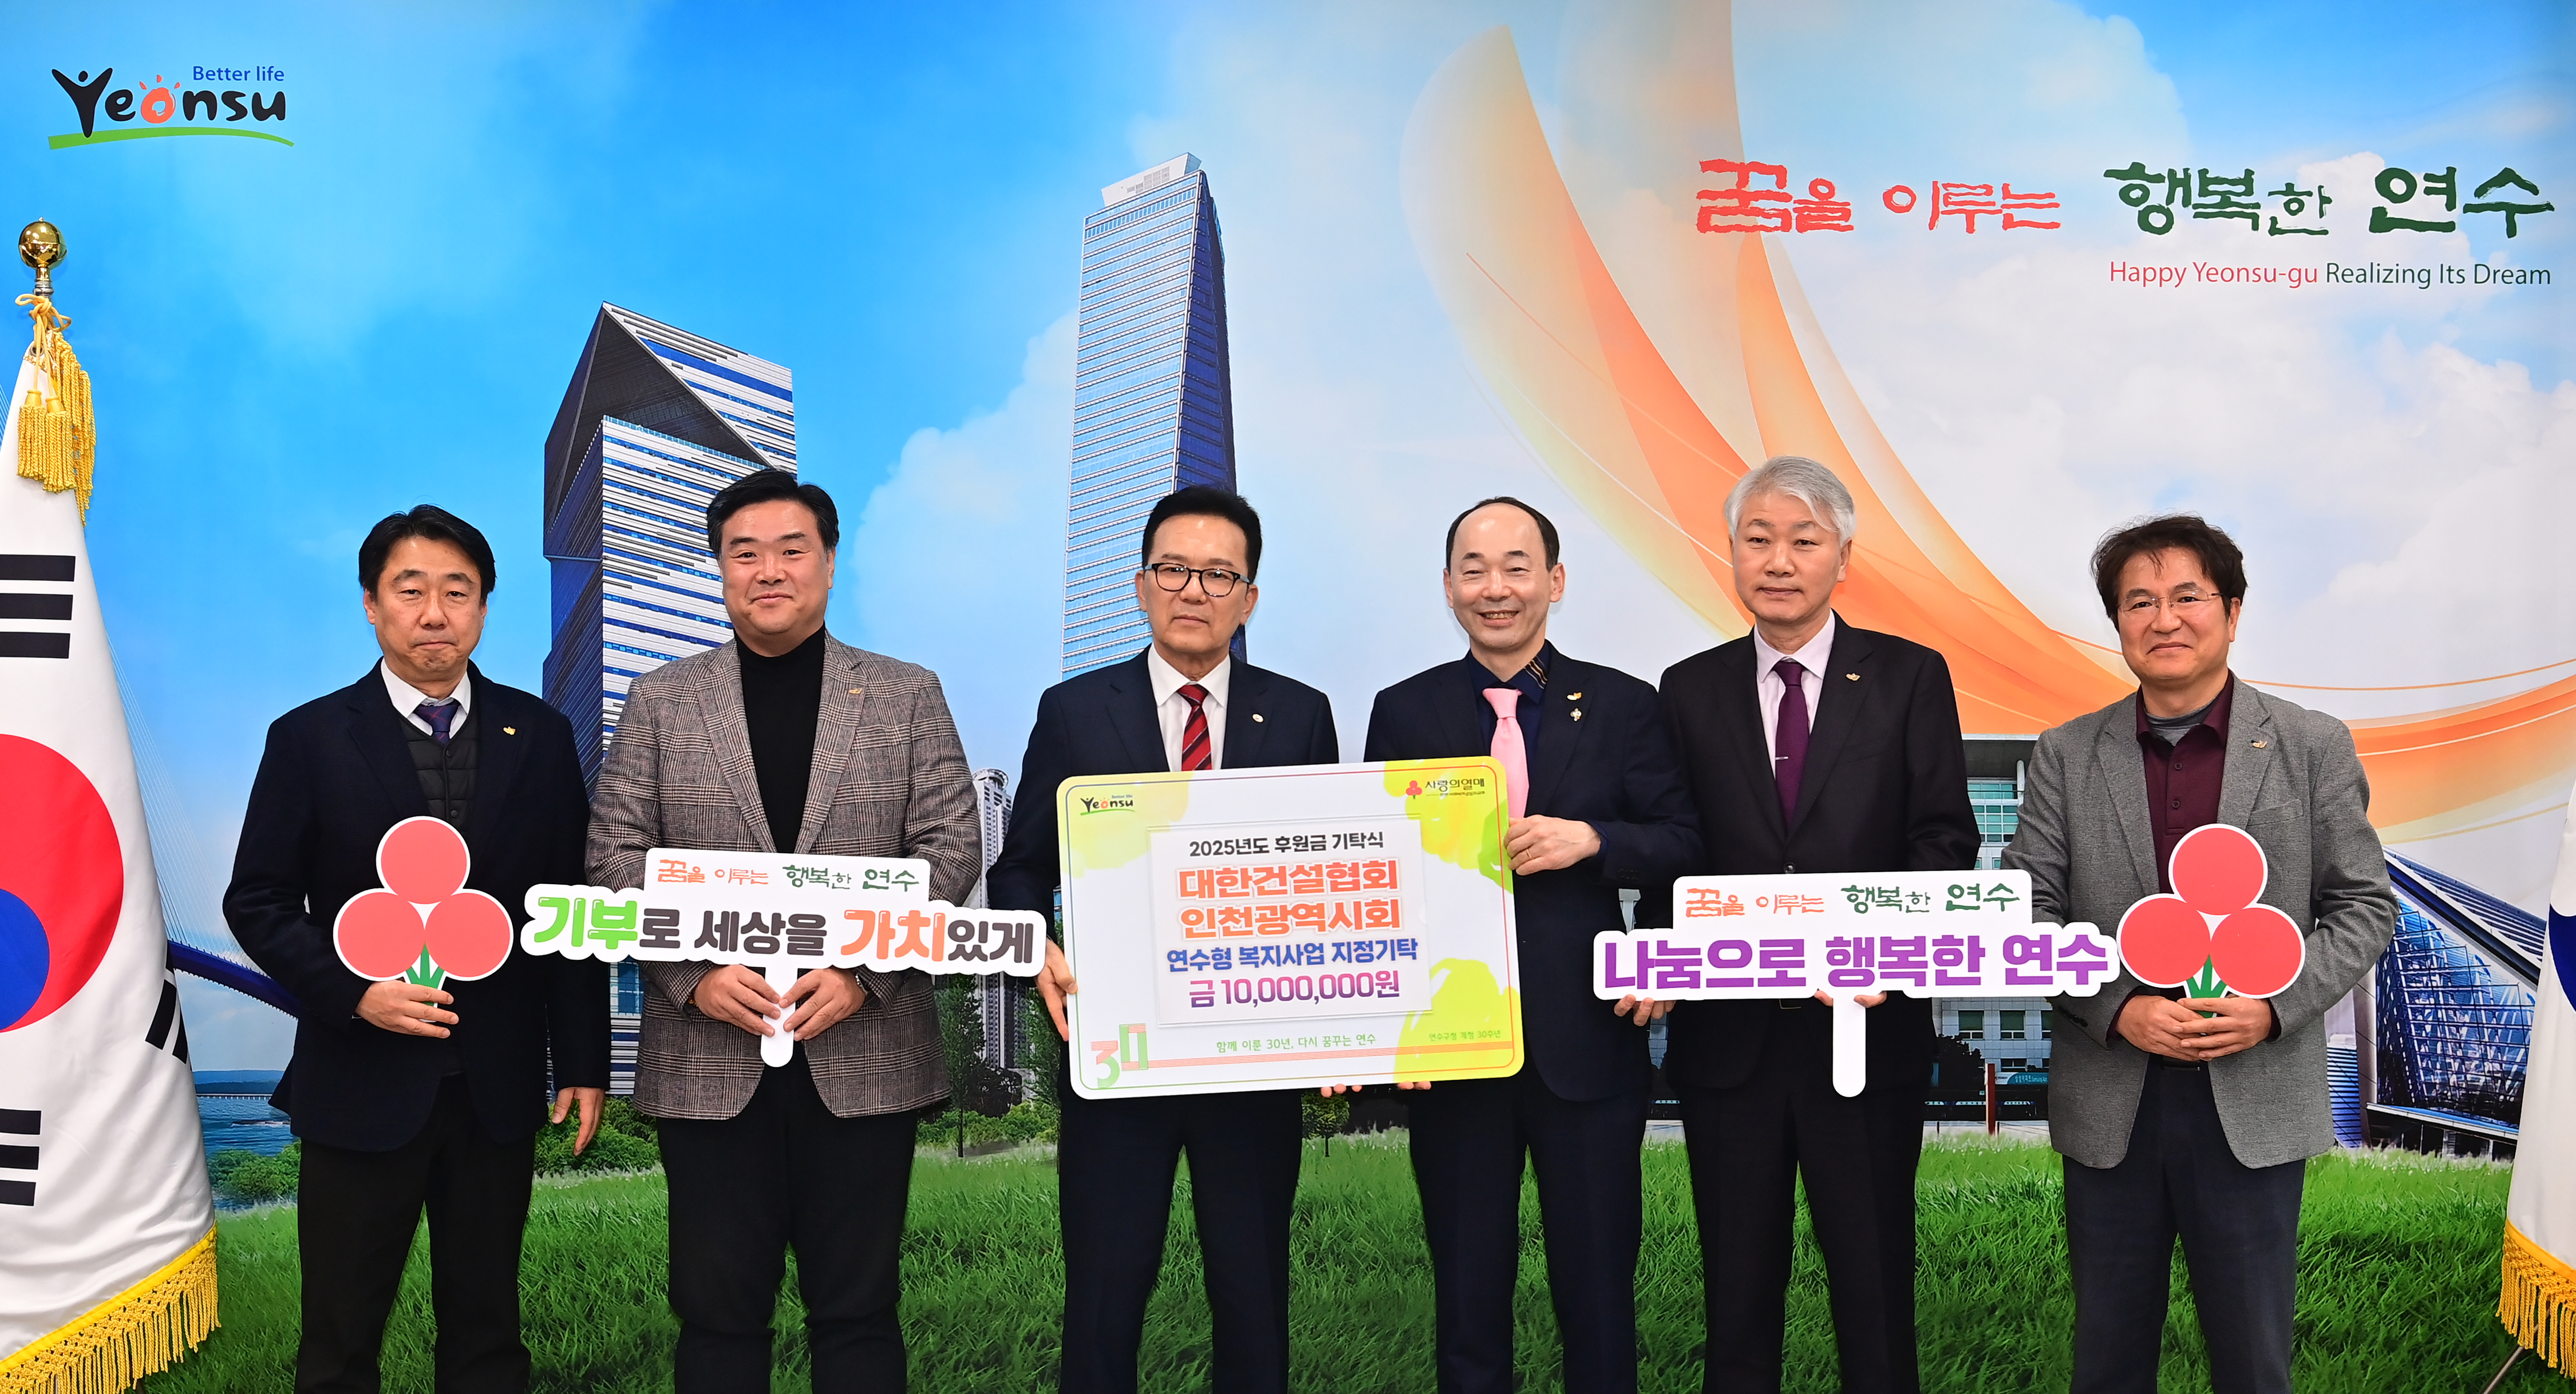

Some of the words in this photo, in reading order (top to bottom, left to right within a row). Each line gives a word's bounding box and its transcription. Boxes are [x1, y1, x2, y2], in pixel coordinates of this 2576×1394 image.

[193, 66, 251, 81] Better
[256, 65, 285, 81] life
[52, 67, 286, 138] Yeonsu
[1695, 158, 1854, 234] 꿈을
[1882, 180, 2061, 234] 이루는
[2103, 161, 2333, 237] 행복한
[2368, 166, 2555, 239] 연수
[2111, 261, 2187, 288] Happy
[2192, 262, 2317, 288] Yeonsu-gu
[2326, 262, 2431, 290] Realizing
[2440, 263, 2466, 284] Its
[2474, 263, 2550, 285] Dream
[1425, 778, 1485, 792] 사랑의열매
[1080, 797, 1133, 813] Yeonsu
[1189, 837, 1270, 857] 2025년도
[1274, 834, 1327, 853] 후원금
[1332, 831, 1384, 850] 기탁식
[657, 859, 706, 884] 꿈을
[714, 868, 769, 885] 이루는
[782, 864, 852, 890] 행복한
[862, 869, 919, 892] 연수
[1179, 860, 1398, 898] 대한건설협회
[1685, 888, 1745, 918] 꿈을
[1756, 894, 1824, 916] 이루는
[1840, 884, 1931, 914] 행복한
[1945, 883, 2020, 912] 연수
[534, 896, 679, 949] 기부로
[694, 910, 827, 956] 세상을
[840, 909, 1034, 964] 가치있게
[1181, 899, 1400, 938] 인천광역시회
[1167, 947, 1232, 972] 연수형
[1239, 942, 1325, 968] 복지사업
[1332, 938, 1419, 964] 지정기탁
[1605, 938, 1806, 989] 나눔으로
[1826, 935, 1986, 987] 행복한
[2002, 934, 2108, 985] 연수
[1189, 980, 1215, 1008] 금
[1220, 970, 1400, 1008] 10,000,000원
[1216, 1041, 1238, 1053] 함께
[1242, 1039, 1262, 1051] 이룬
[1298, 1036, 1318, 1047] 다시
[1322, 1035, 1352, 1047] 꿈꾸는
[1356, 1033, 1376, 1046] 연수
